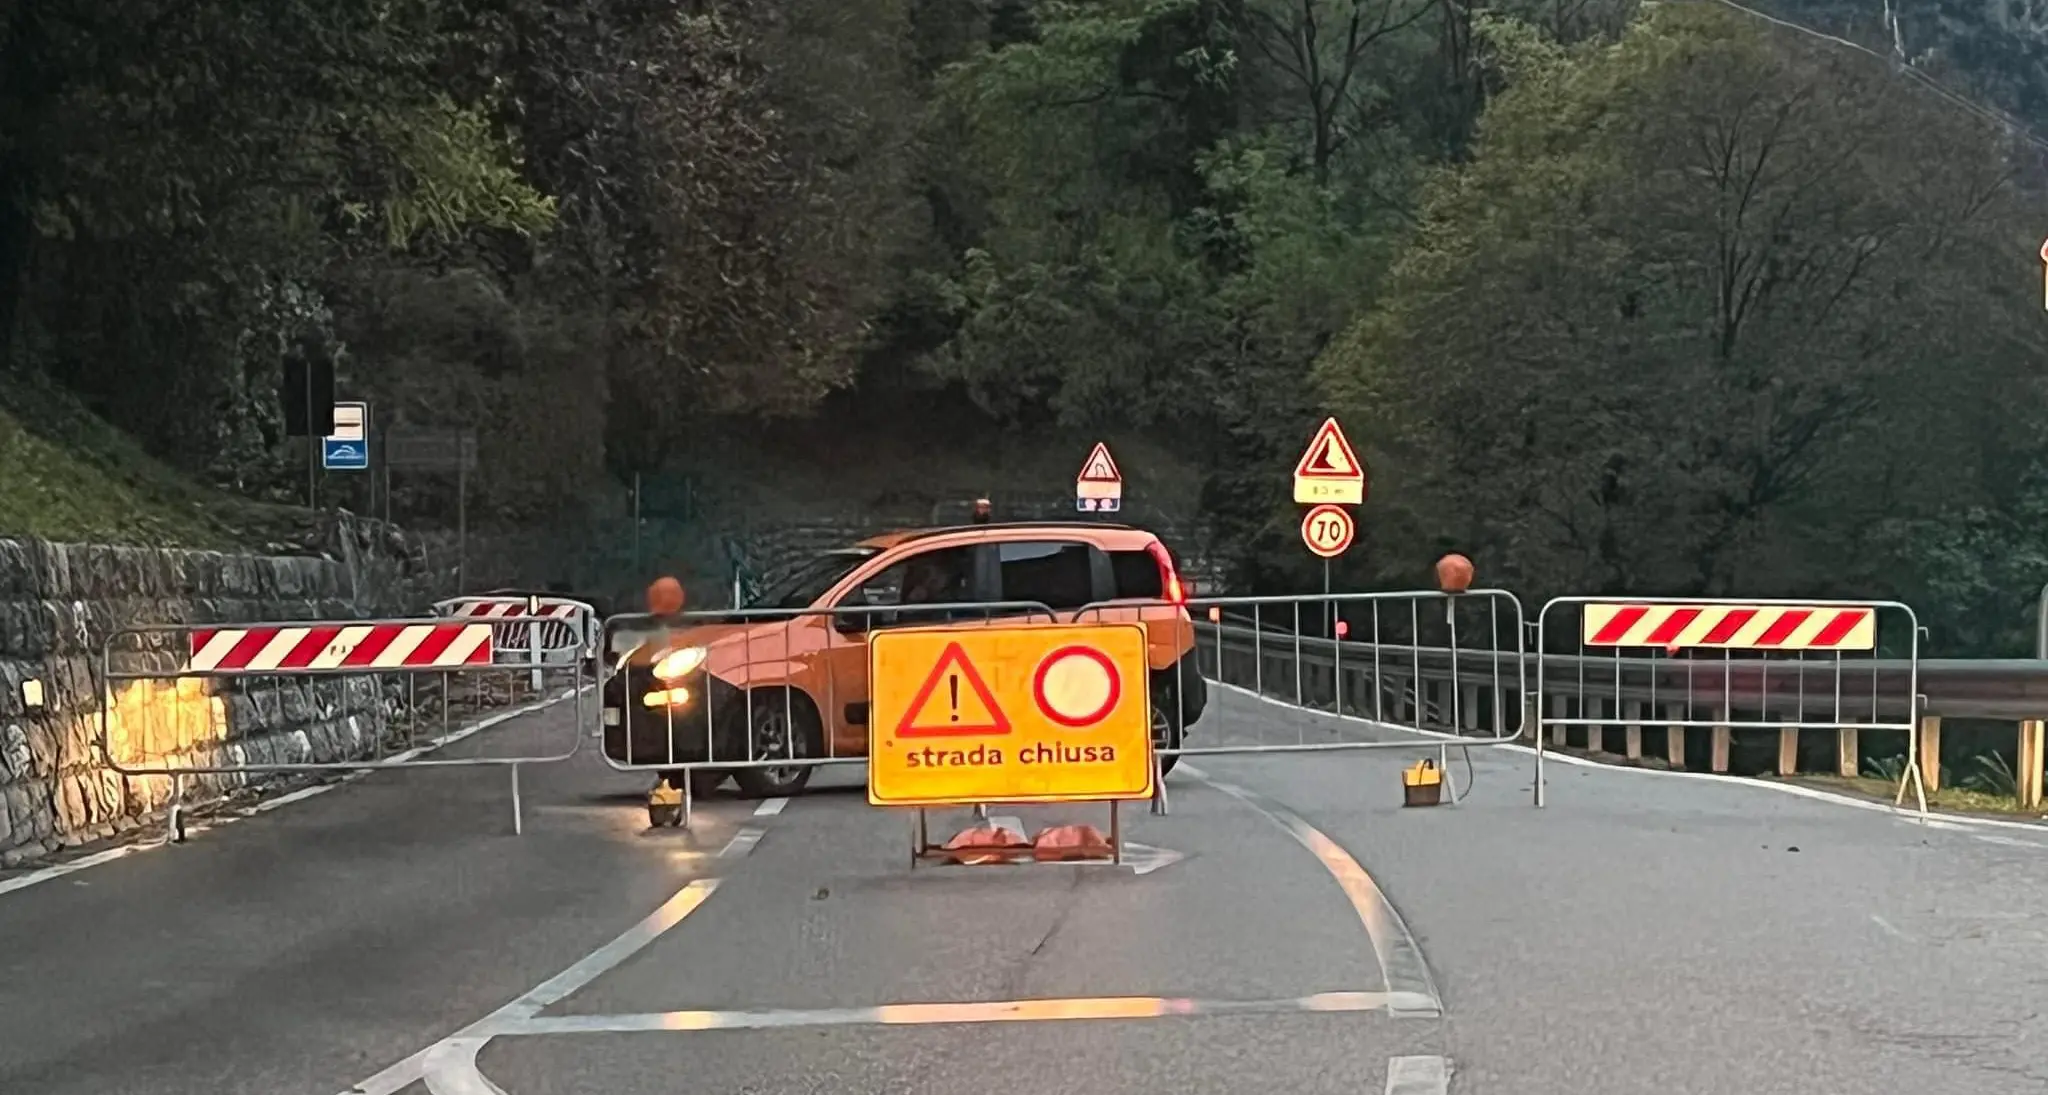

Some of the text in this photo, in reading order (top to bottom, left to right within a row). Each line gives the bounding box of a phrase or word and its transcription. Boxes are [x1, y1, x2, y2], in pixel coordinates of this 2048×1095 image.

[1317, 520, 1341, 542] 70
[906, 741, 1115, 768] strada chiusa
